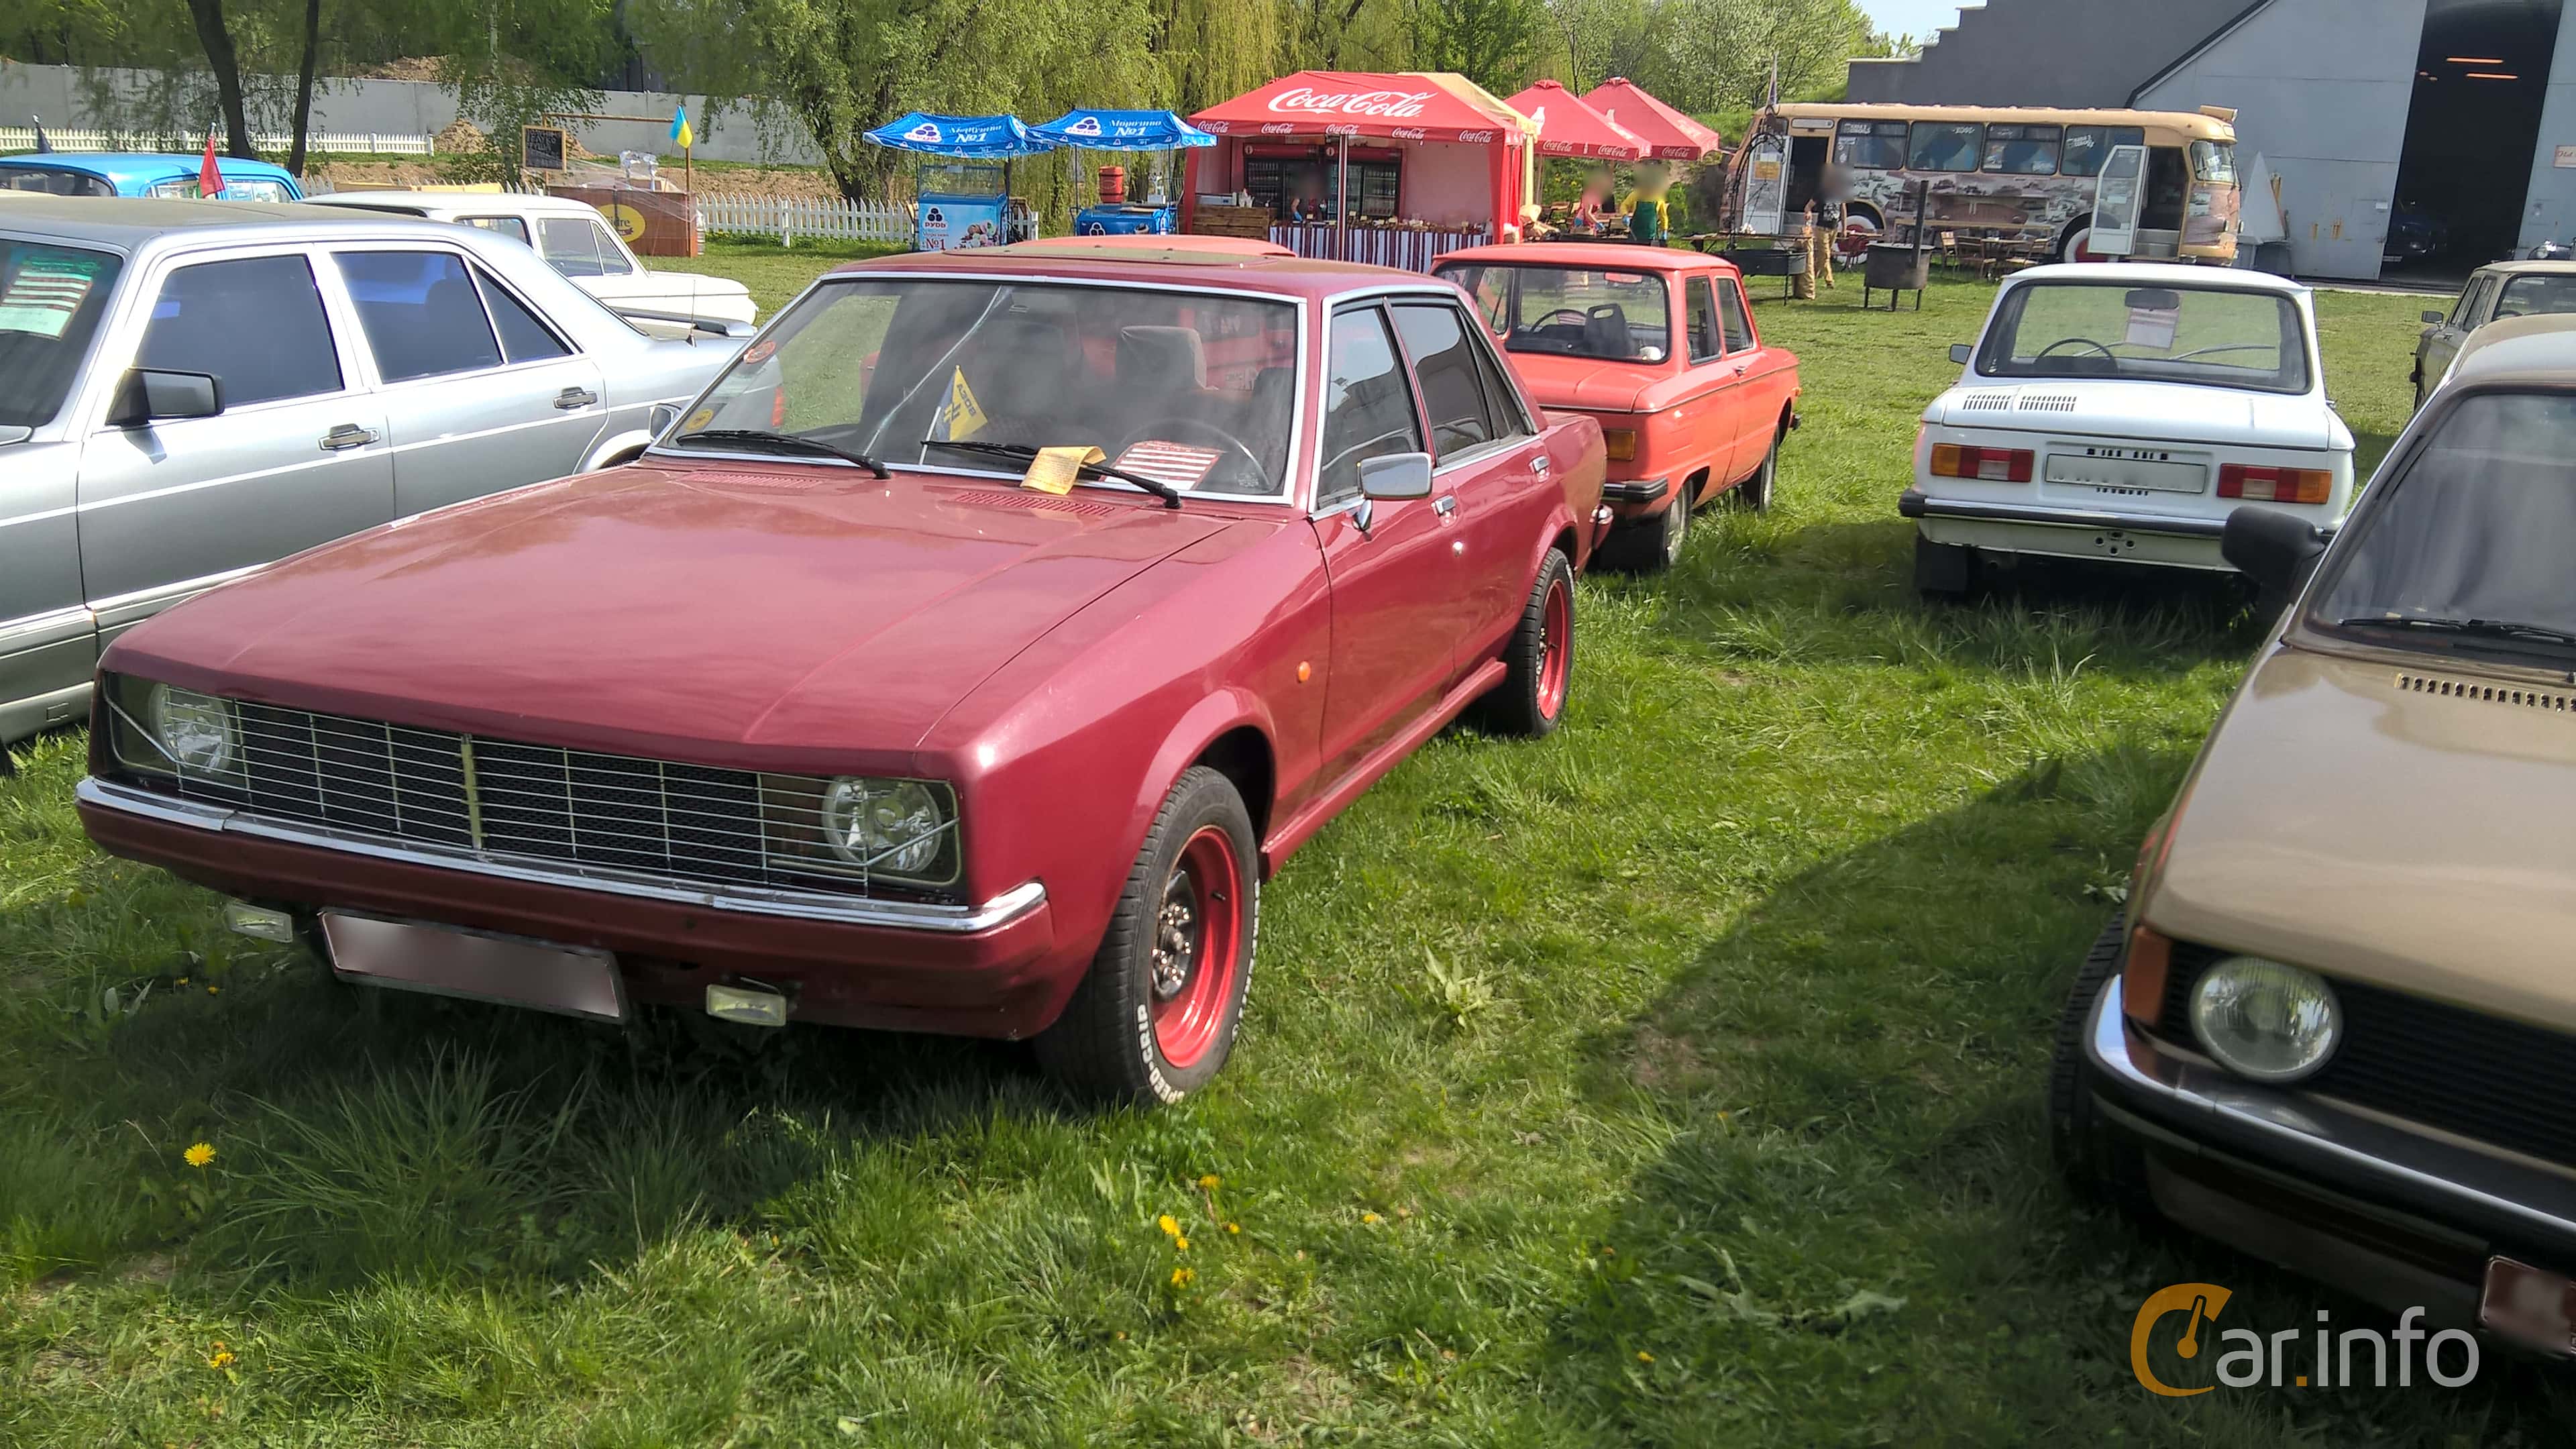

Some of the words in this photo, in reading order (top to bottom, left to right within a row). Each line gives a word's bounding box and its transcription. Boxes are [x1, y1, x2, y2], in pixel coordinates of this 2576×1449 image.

[1268, 87, 1438, 118] Coca-Cola
[1197, 121, 1229, 133] Coca-Cola
[1261, 123, 1294, 134] Coca-Cola
[1326, 123, 1359, 135] Coca-Cola
[1391, 127, 1427, 140] Coca-Cola
[1458, 129, 1493, 144] Coca-Cola
[1543, 140, 1572, 152] Coca-Cola
[1598, 144, 1627, 157] Coca-Cola
[1661, 146, 1690, 157] Coca-Cola
